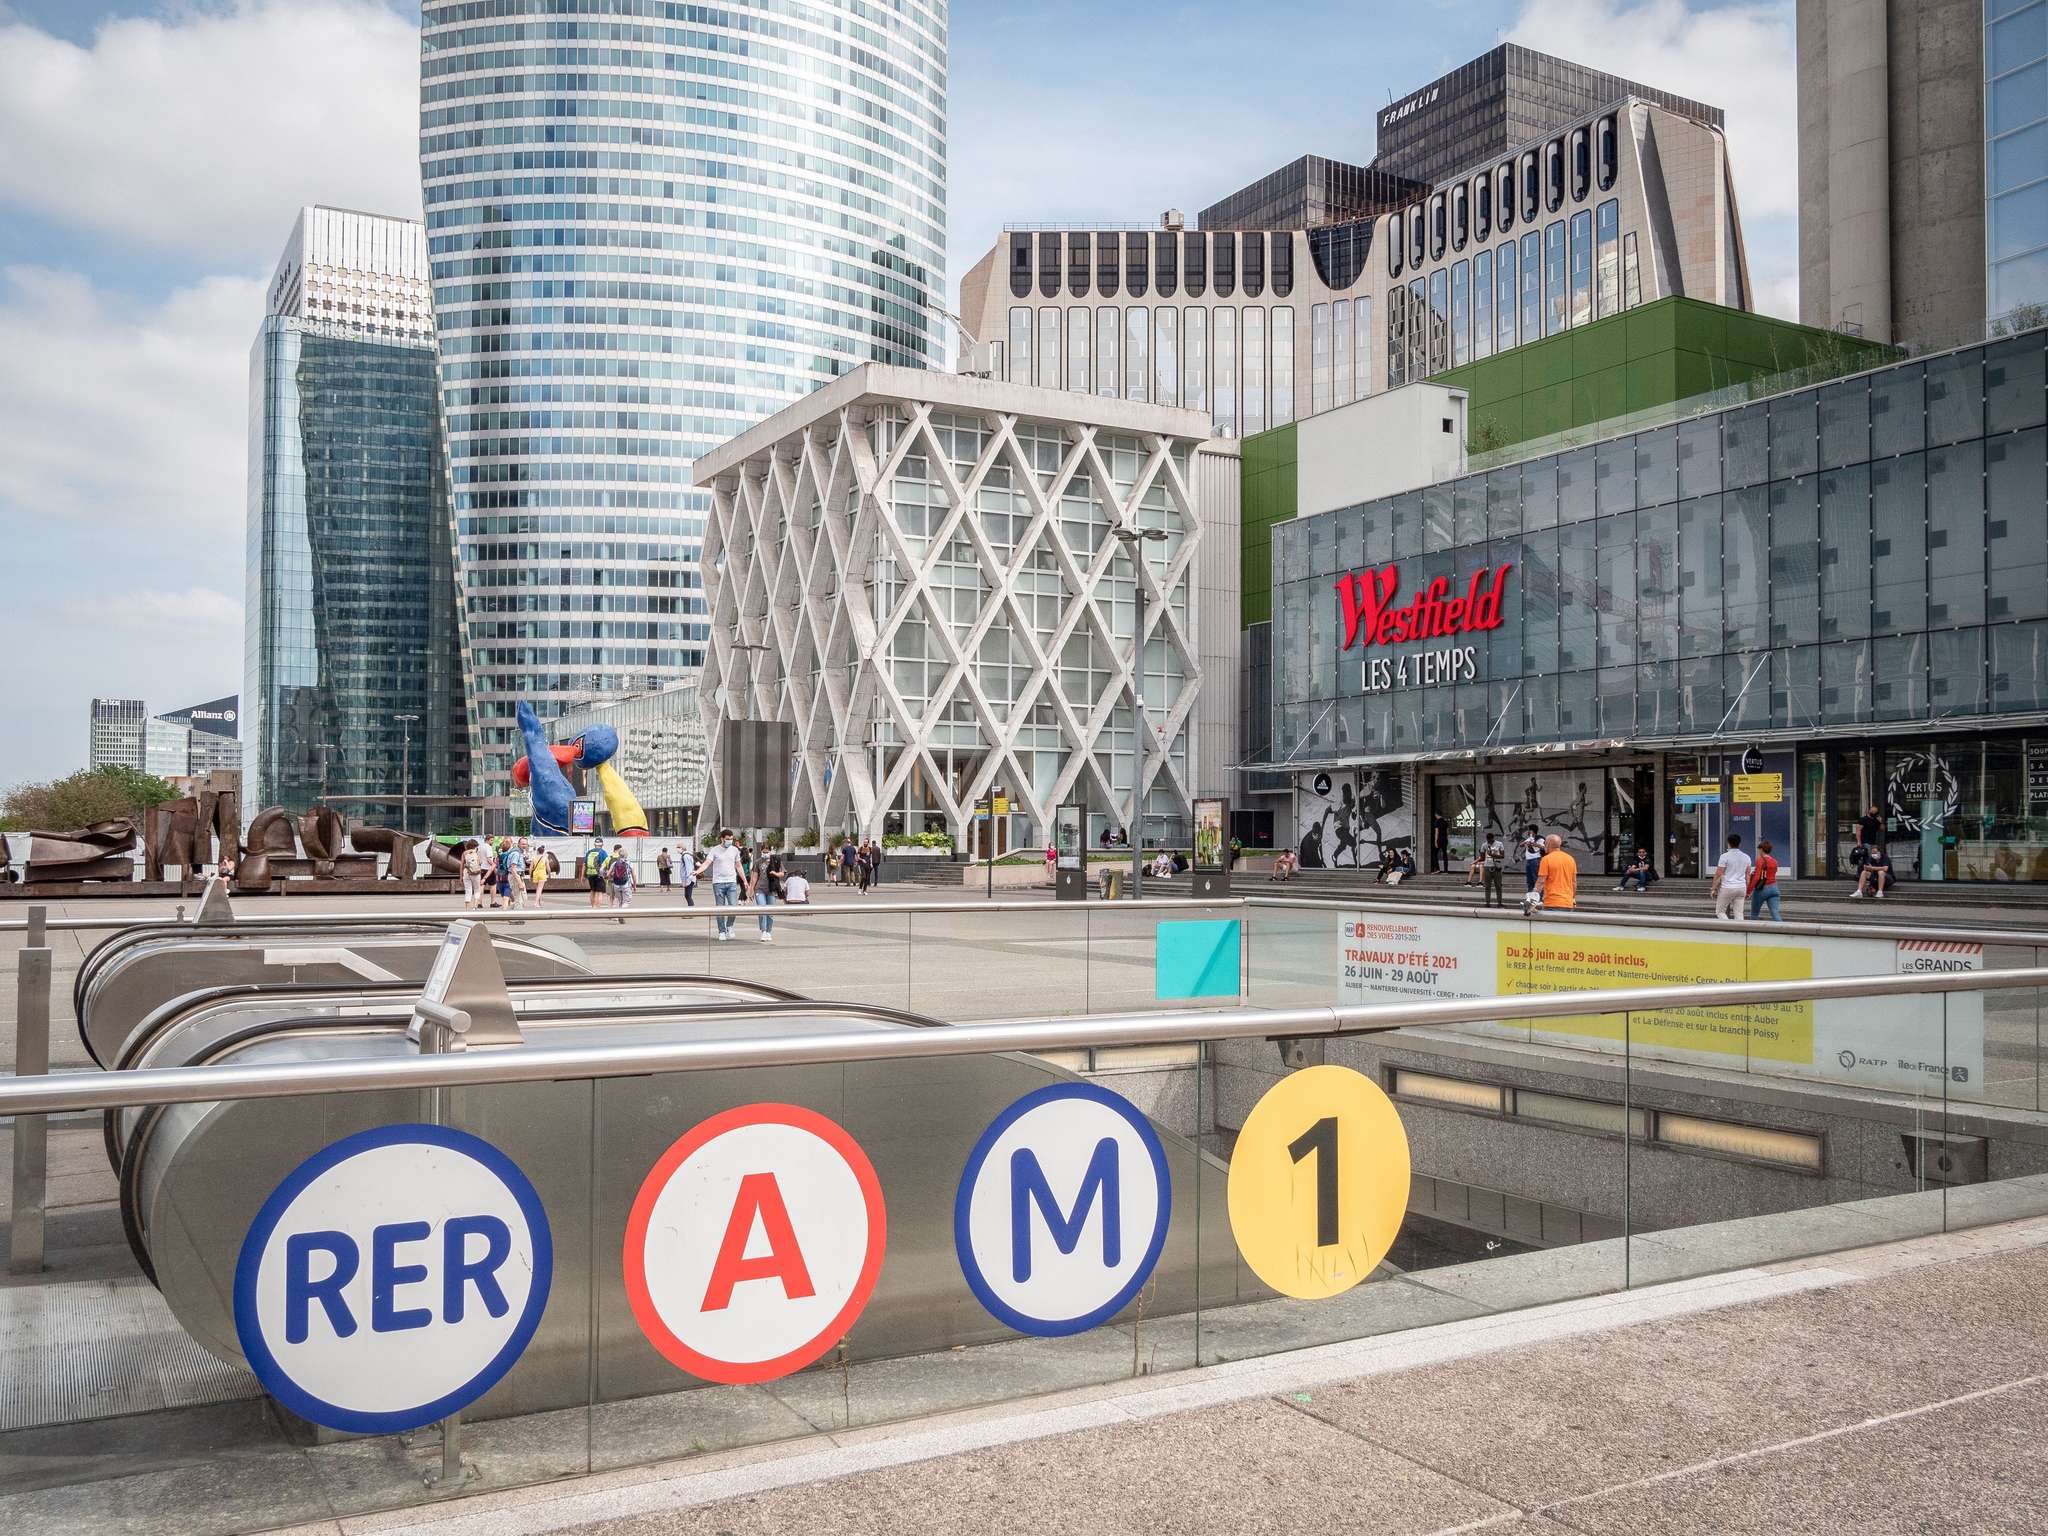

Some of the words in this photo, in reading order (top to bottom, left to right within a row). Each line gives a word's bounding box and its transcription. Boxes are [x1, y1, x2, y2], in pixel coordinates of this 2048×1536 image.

[1383, 87, 1439, 128] FRANKLIN
[1334, 563, 1512, 651] Westfield
[1361, 658, 1392, 691] LES
[1397, 656, 1408, 686] 4
[1412, 646, 1476, 685] TEMPS
[191, 710, 223, 720] Allianz
[1902, 781, 1942, 793] VERTUS
[1366, 923, 1418, 933] RENOUVELLEMENT
[1378, 932, 1394, 940] VOIES
[1345, 949, 1394, 965] TRAVAUX
[1397, 951, 1429, 967] D'ÉTÉ
[1432, 955, 1458, 969] 2021
[1506, 946, 1520, 957] Du
[1522, 948, 1534, 959] 26
[1536, 949, 1556, 961] juin
[1558, 952, 1570, 961] au
[1572, 951, 1585, 961] 29
[1587, 952, 1611, 964] août
[1614, 954, 1649, 968] inclus,
[1902, 962, 1913, 970] LES
[1914, 958, 1972, 971] GRANDS
[1344, 965, 1356, 977] 26
[1358, 966, 1383, 980] JUIN
[1391, 969, 1404, 981] 29
[1406, 969, 1438, 985] AOÛT
[1506, 961, 1512, 969] le
[1513, 962, 1527, 970] RER
[1535, 964, 1545, 972] est
[1545, 964, 1566, 973] fermé
[1566, 966, 1585, 975] entre
[1586, 967, 1608, 976] Auber
[1608, 969, 1616, 977] et
[1617, 969, 1689, 984] Nanterre-Université
[1370, 983, 1432, 996] NANTERRE-UNIVERSITÉ
[1436, 991, 1455, 999] CERGY
[1515, 980, 1537, 990] chaque
[1539, 981, 1551, 990] soir
[1686, 1008, 1704, 1017] août
[1706, 1010, 1728, 1020] inclus
[1730, 1013, 1752, 1022] entre
[1754, 1015, 1779, 1025] Auber
[1773, 1002, 1779, 1011] 9
[1780, 1004, 1792, 1012] au
[1794, 1004, 1804, 1013] 13
[1632, 1016, 1641, 1024] et
[1642, 1017, 1652, 1025] La
[1653, 1018, 1684, 1029] Défense
[1685, 1022, 1694, 1030] et
[1709, 1023, 1718, 1033] la
[1719, 1025, 1751, 1037] branche
[1753, 1028, 1780, 1041] Poissy
[1858, 1057, 1888, 1067] RATP
[1918, 1062, 1950, 1074] France
[1287, 1116, 1339, 1248] 1
[1010, 1136, 1121, 1284] M
[699, 1171, 817, 1313] A
[285, 1214, 511, 1345] RER
